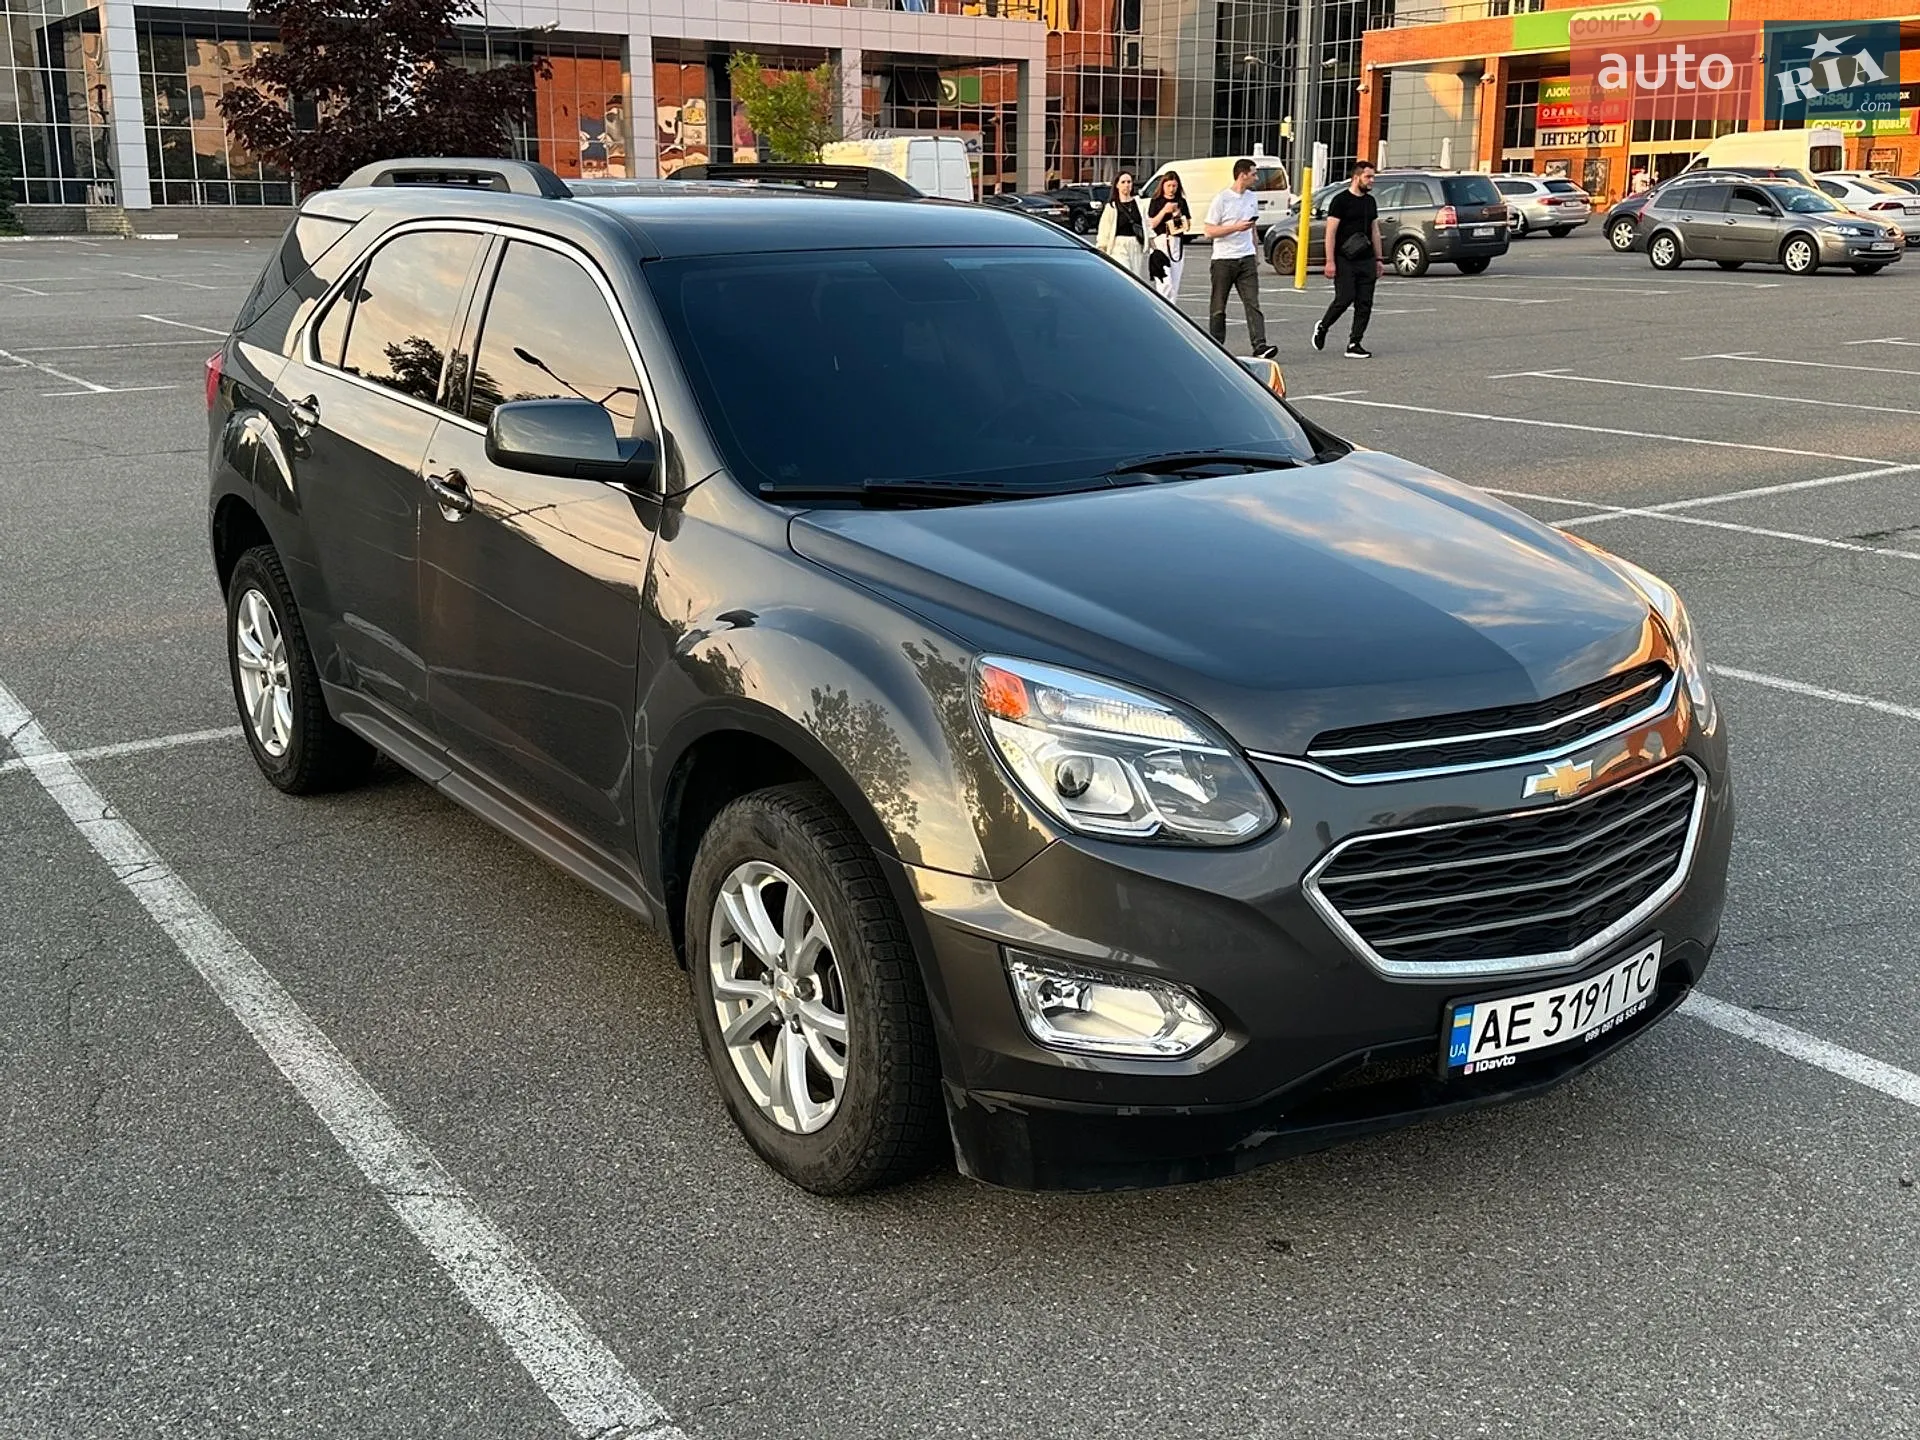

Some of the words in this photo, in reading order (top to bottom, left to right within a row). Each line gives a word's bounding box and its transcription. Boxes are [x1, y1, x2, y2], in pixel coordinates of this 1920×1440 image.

[1573, 12, 1641, 35] COMFY
[1863, 91, 1871, 102] 3
[1814, 120, 1854, 131] COMFY
[1542, 129, 1616, 147] ІНТЕРТОП
[1474, 1001, 1535, 1054] AE
[1543, 973, 1615, 1038] 3191
[1622, 952, 1655, 1003] TC
[1449, 1043, 1466, 1058] UA
